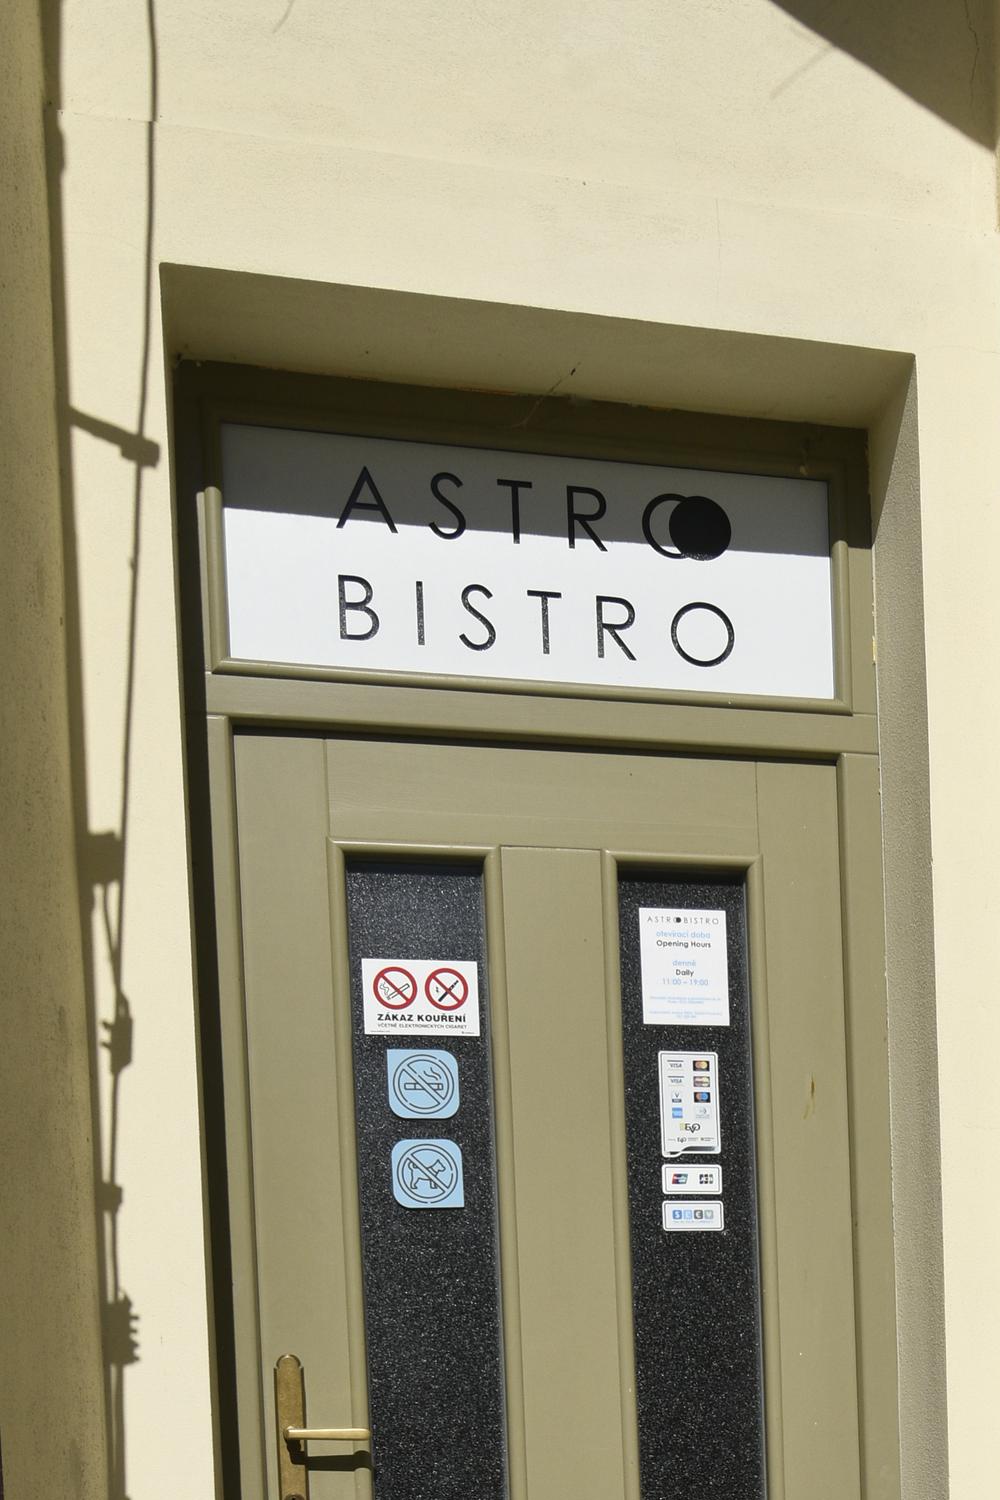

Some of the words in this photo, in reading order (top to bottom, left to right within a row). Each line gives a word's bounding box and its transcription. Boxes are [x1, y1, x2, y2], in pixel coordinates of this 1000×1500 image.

[336, 465, 732, 560] ASTRO
[337, 573, 735, 667] BISTRO
[684, 917, 719, 925] BISTRO
[656, 940, 689, 948] Opening
[676, 969, 694, 977] Daily
[377, 1012, 414, 1022] ZÁKAZ
[417, 1012, 466, 1023] KOUŘENÍ
